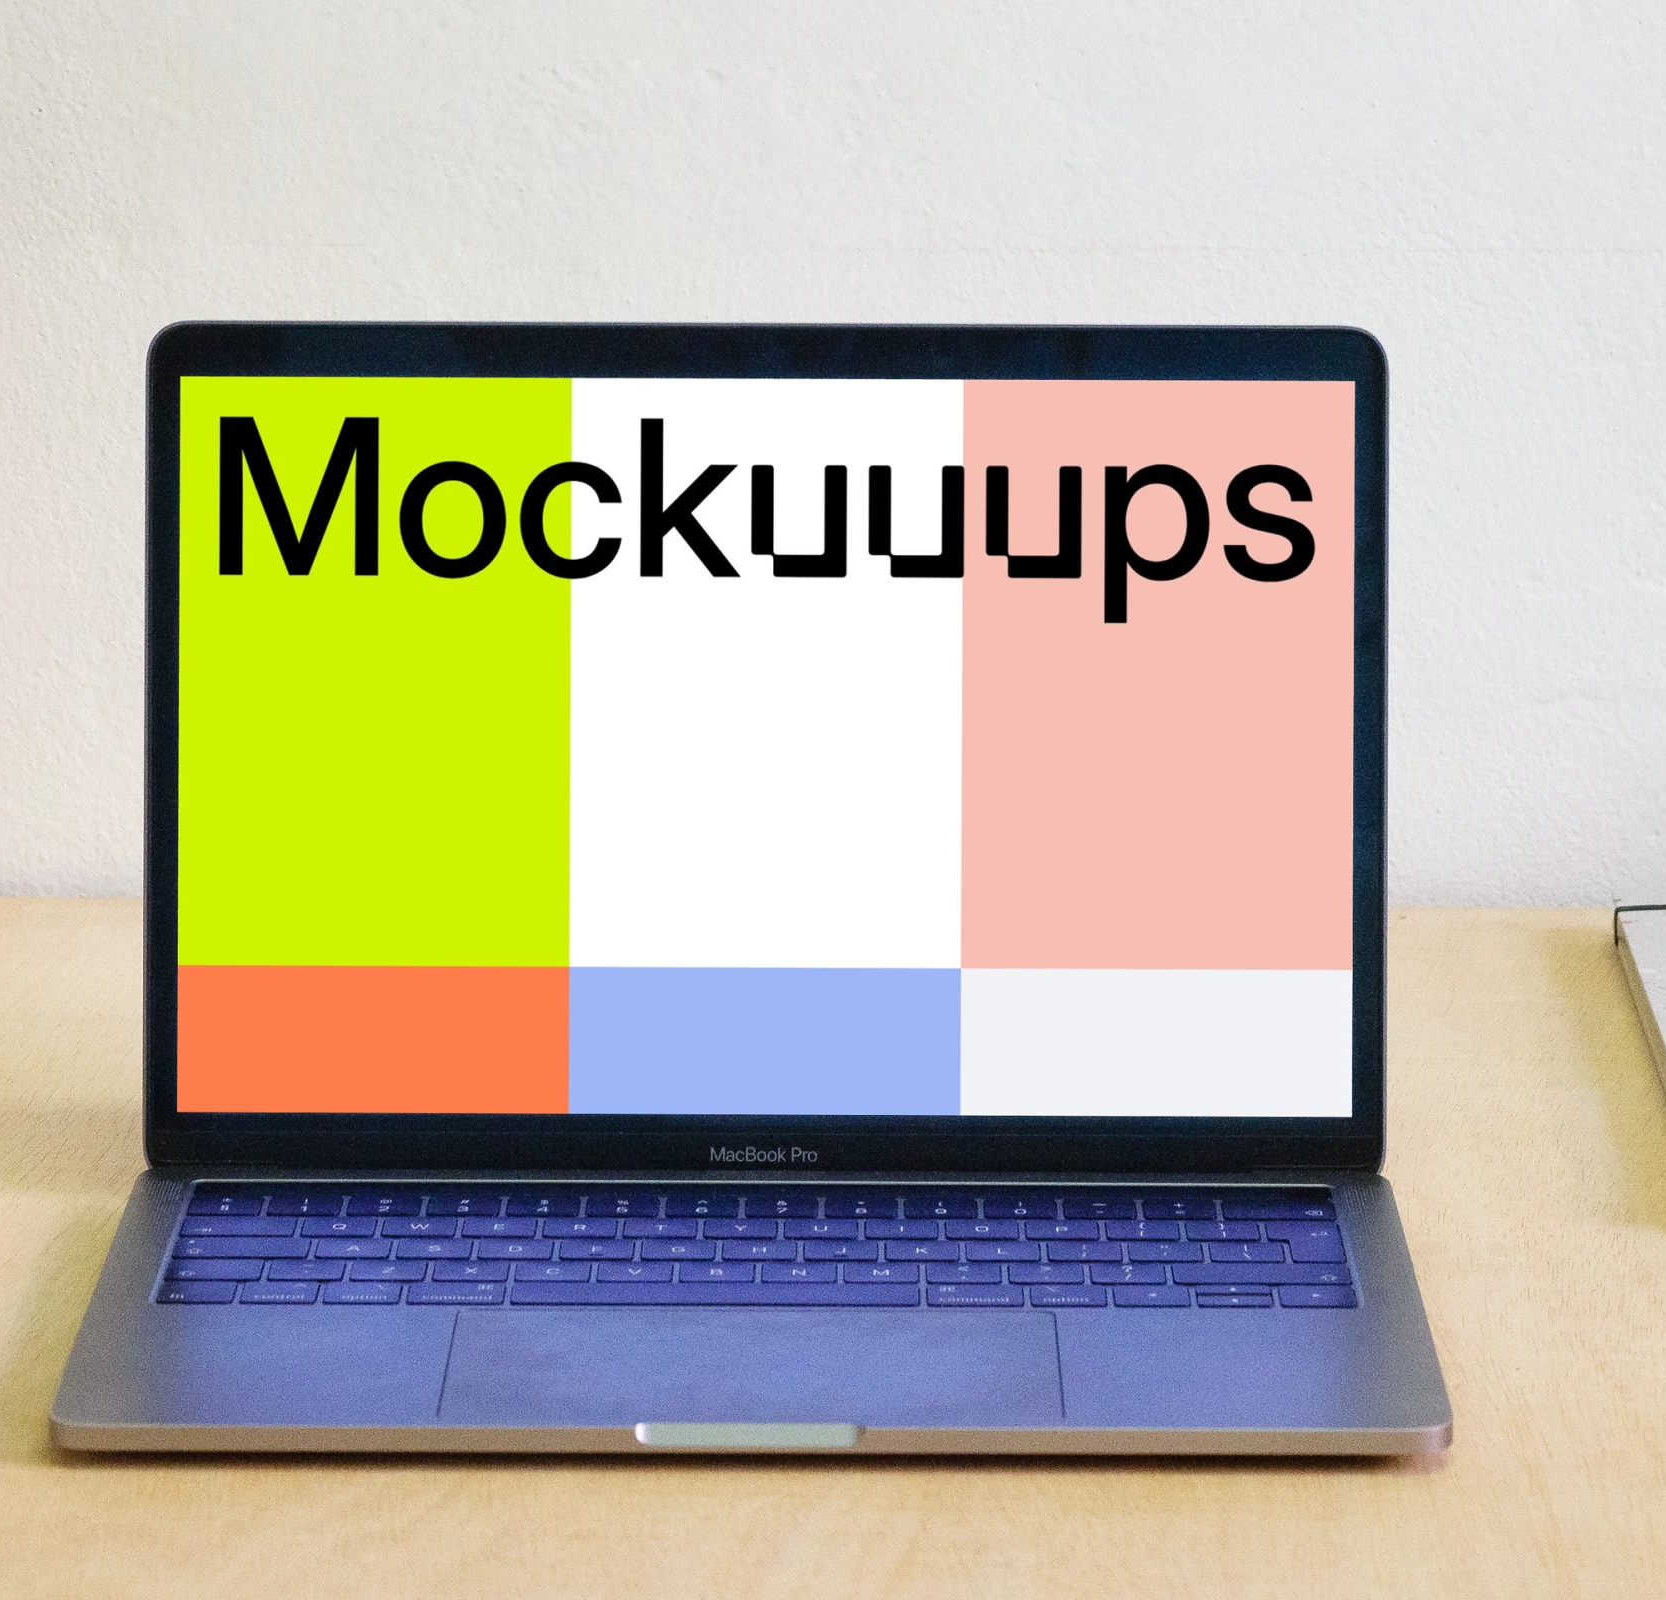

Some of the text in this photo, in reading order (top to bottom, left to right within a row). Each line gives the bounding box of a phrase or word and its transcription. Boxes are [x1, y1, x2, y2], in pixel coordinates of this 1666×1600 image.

[219, 416, 1317, 623] Mockuuups
[710, 1146, 818, 1162] MacBook Pro
